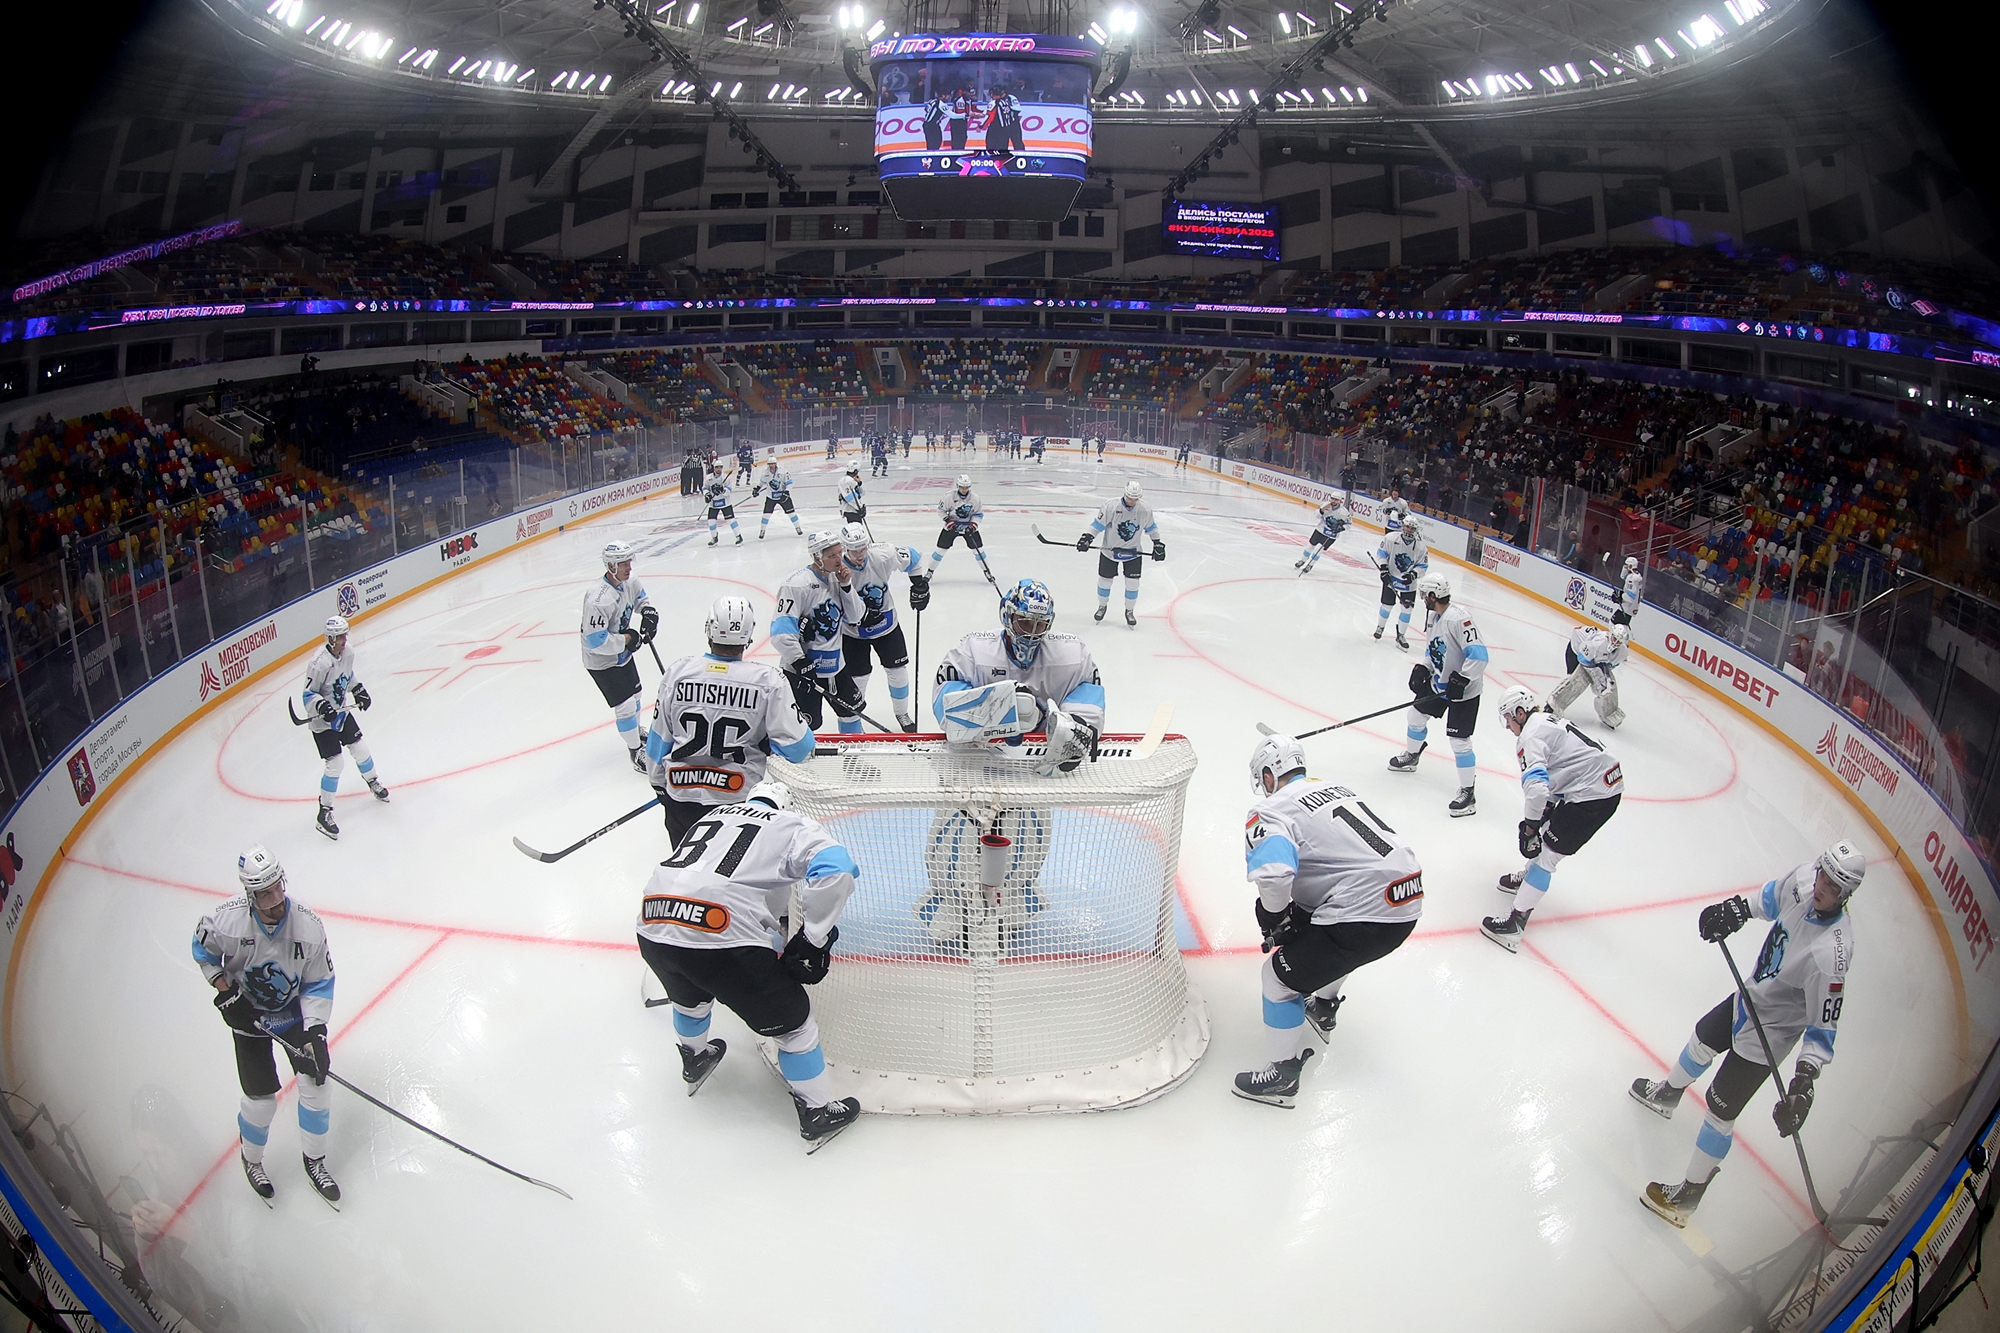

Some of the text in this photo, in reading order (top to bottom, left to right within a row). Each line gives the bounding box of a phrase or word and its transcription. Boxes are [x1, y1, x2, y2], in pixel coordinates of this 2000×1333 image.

[900, 39, 935, 53] ПО
[934, 37, 1035, 52] ХОККЕЮ
[940, 157, 951, 169] 0
[970, 160, 995, 168] 00:00
[1016, 157, 1027, 169] 0
[1178, 209, 1265, 219] ДЕЛИСЬ ПОСТАМИ
[1168, 224, 1275, 238] #КУБОКМЭРА2025
[783, 445, 811, 453] OLIMPBET
[1139, 447, 1168, 456] OLIMPBET
[582, 493, 607, 512] КУБОК
[607, 488, 625, 503] МЭРА
[625, 479, 651, 496] МОСКВЫ
[651, 477, 661, 489] ПО
[1257, 472, 1274, 486] КУБОК
[1273, 477, 1288, 490] МЭРА
[1288, 482, 1312, 498] МОСКВЫ
[1312, 488, 1322, 500] ПО
[1354, 501, 1373, 517] 2025
[526, 506, 554, 524] МОСКОВСКИЙ
[527, 523, 541, 537] СПОРТ
[453, 555, 471, 568] РАДИО
[1481, 556, 1499, 572] СПОРТ
[1483, 543, 1521, 569] МОСКОВСКИЙ
[358, 569, 388, 586] Федерация
[365, 582, 384, 595] хоккея
[1590, 586, 1613, 601] Федера
[365, 592, 387, 607] Москвы
[777, 598, 795, 614] 87
[1594, 600, 1614, 614] хоккея
[590, 615, 605, 629] 44
[729, 621, 741, 632] 26
[1463, 627, 1479, 644] 27
[218, 620, 278, 669] МОСКОВСКИЙ
[222, 656, 251, 687] СПОРТ
[1664, 632, 1780, 709] OLIMPBET
[676, 682, 759, 710] SOTISHVILI
[89, 715, 129, 758] Департамент
[671, 712, 753, 765] 26
[94, 745, 115, 770] спорта
[98, 737, 142, 785] города Москвы
[1295, 756, 1304, 766] 14
[1842, 733, 1901, 797] МОСКОВСКИЙ
[671, 770, 728, 787] WINLINE
[1837, 754, 1866, 792] СПОРТ
[1298, 786, 1357, 812] KUZNETSO
[254, 853, 265, 863] 61
[660, 820, 763, 879] 81
[1393, 877, 1424, 901] WINL
[215, 897, 248, 913] Belavia
[1924, 830, 1995, 974] OLIMPBET
[6, 894, 24, 935] РАДИО
[645, 901, 705, 923] WINLINE
[293, 941, 305, 960] A
[1833, 928, 1845, 972] Belavia
[1822, 997, 1844, 1024] 68
